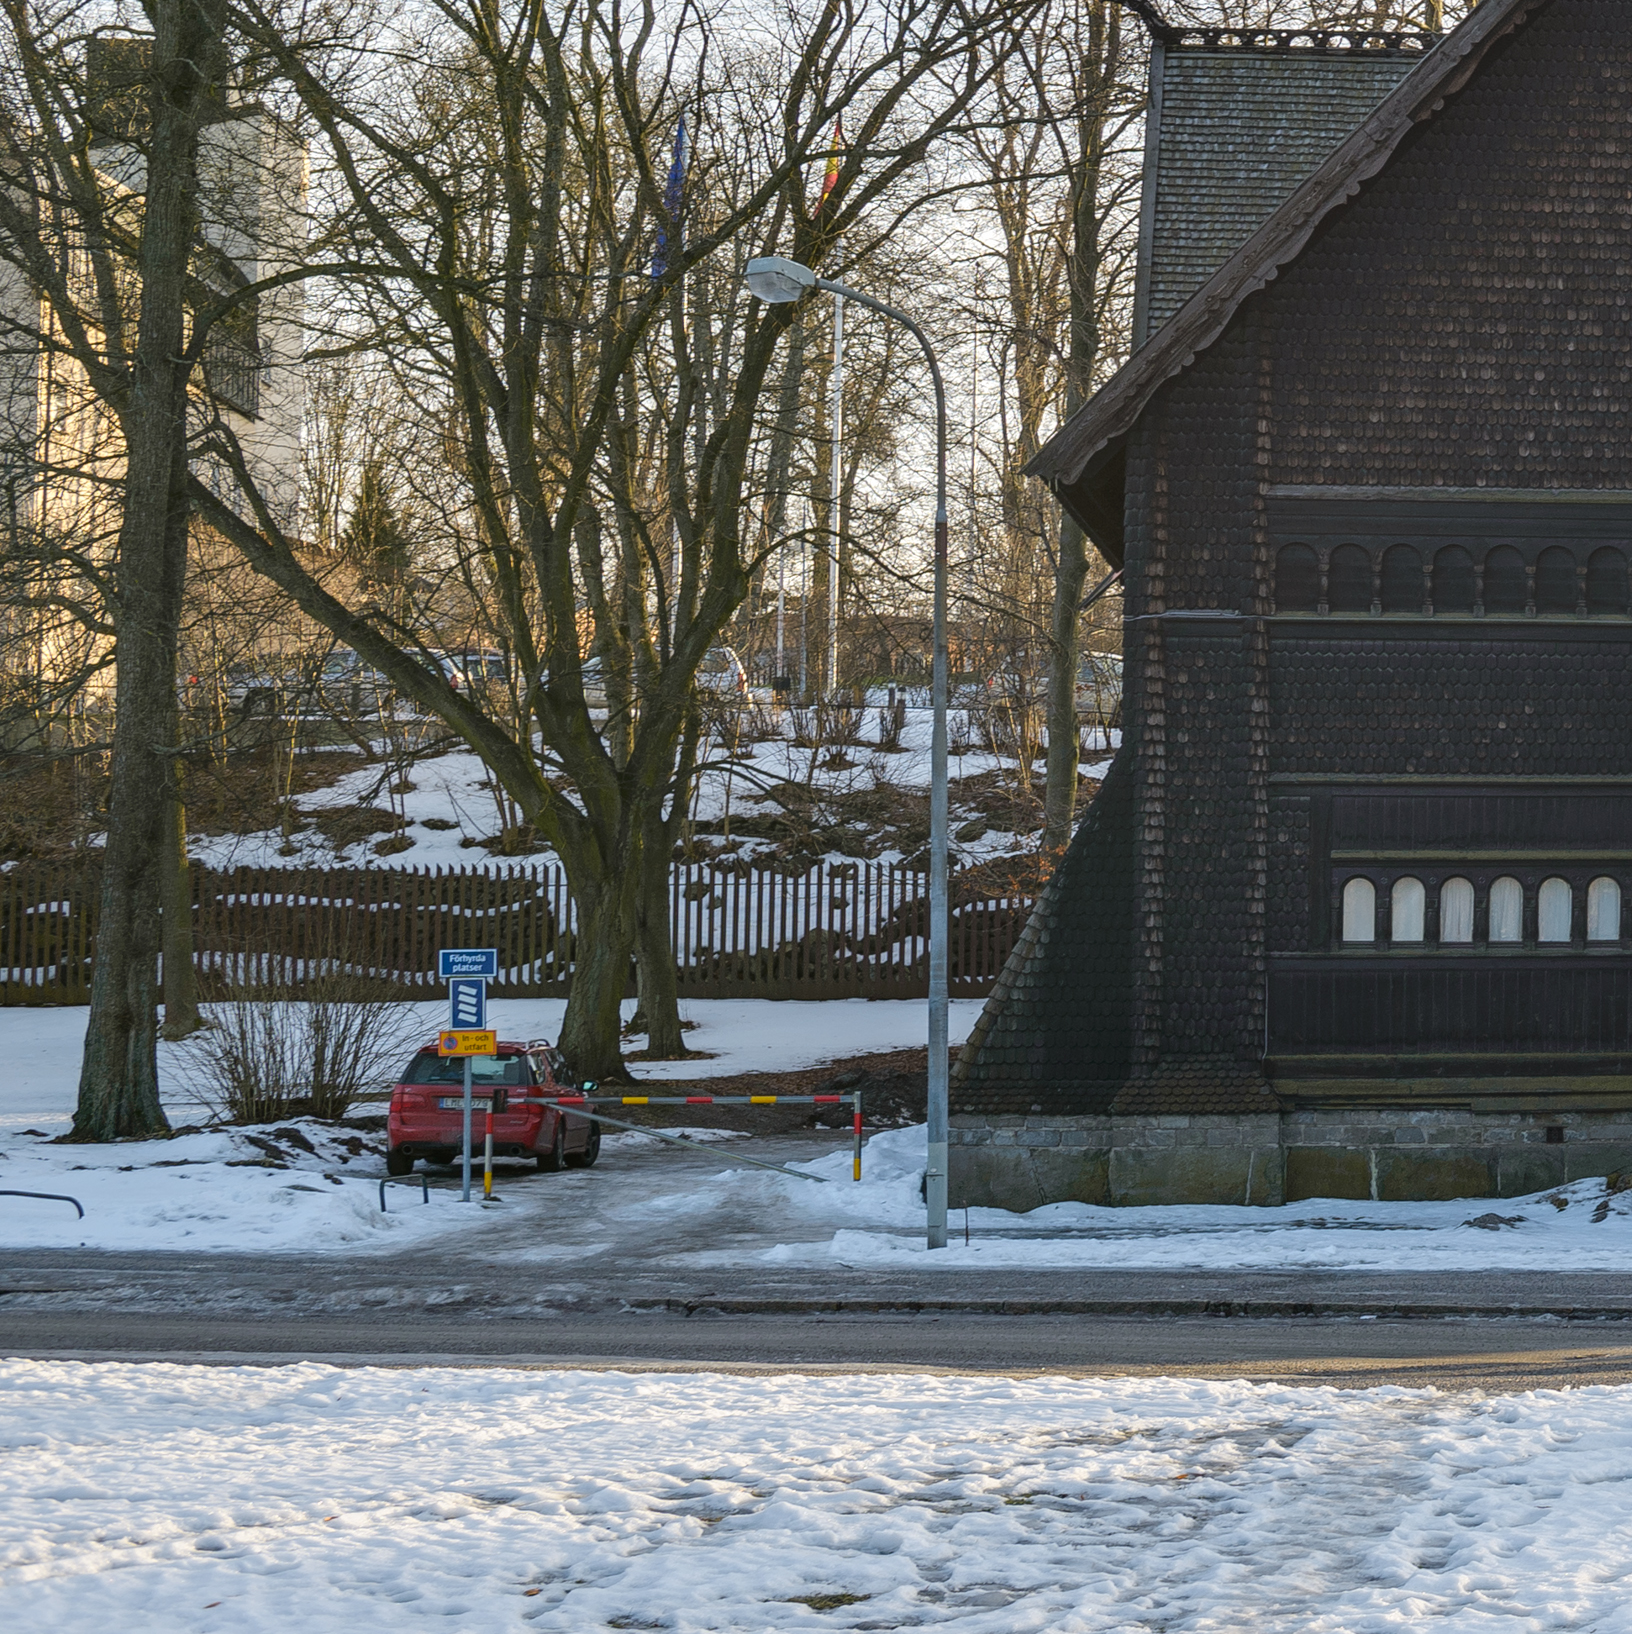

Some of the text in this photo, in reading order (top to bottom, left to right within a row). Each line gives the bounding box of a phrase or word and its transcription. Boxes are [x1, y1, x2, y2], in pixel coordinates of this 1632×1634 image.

[449, 953, 486, 964] Förhyrda
[452, 963, 483, 973] platser
[464, 1043, 487, 1051] utfart
